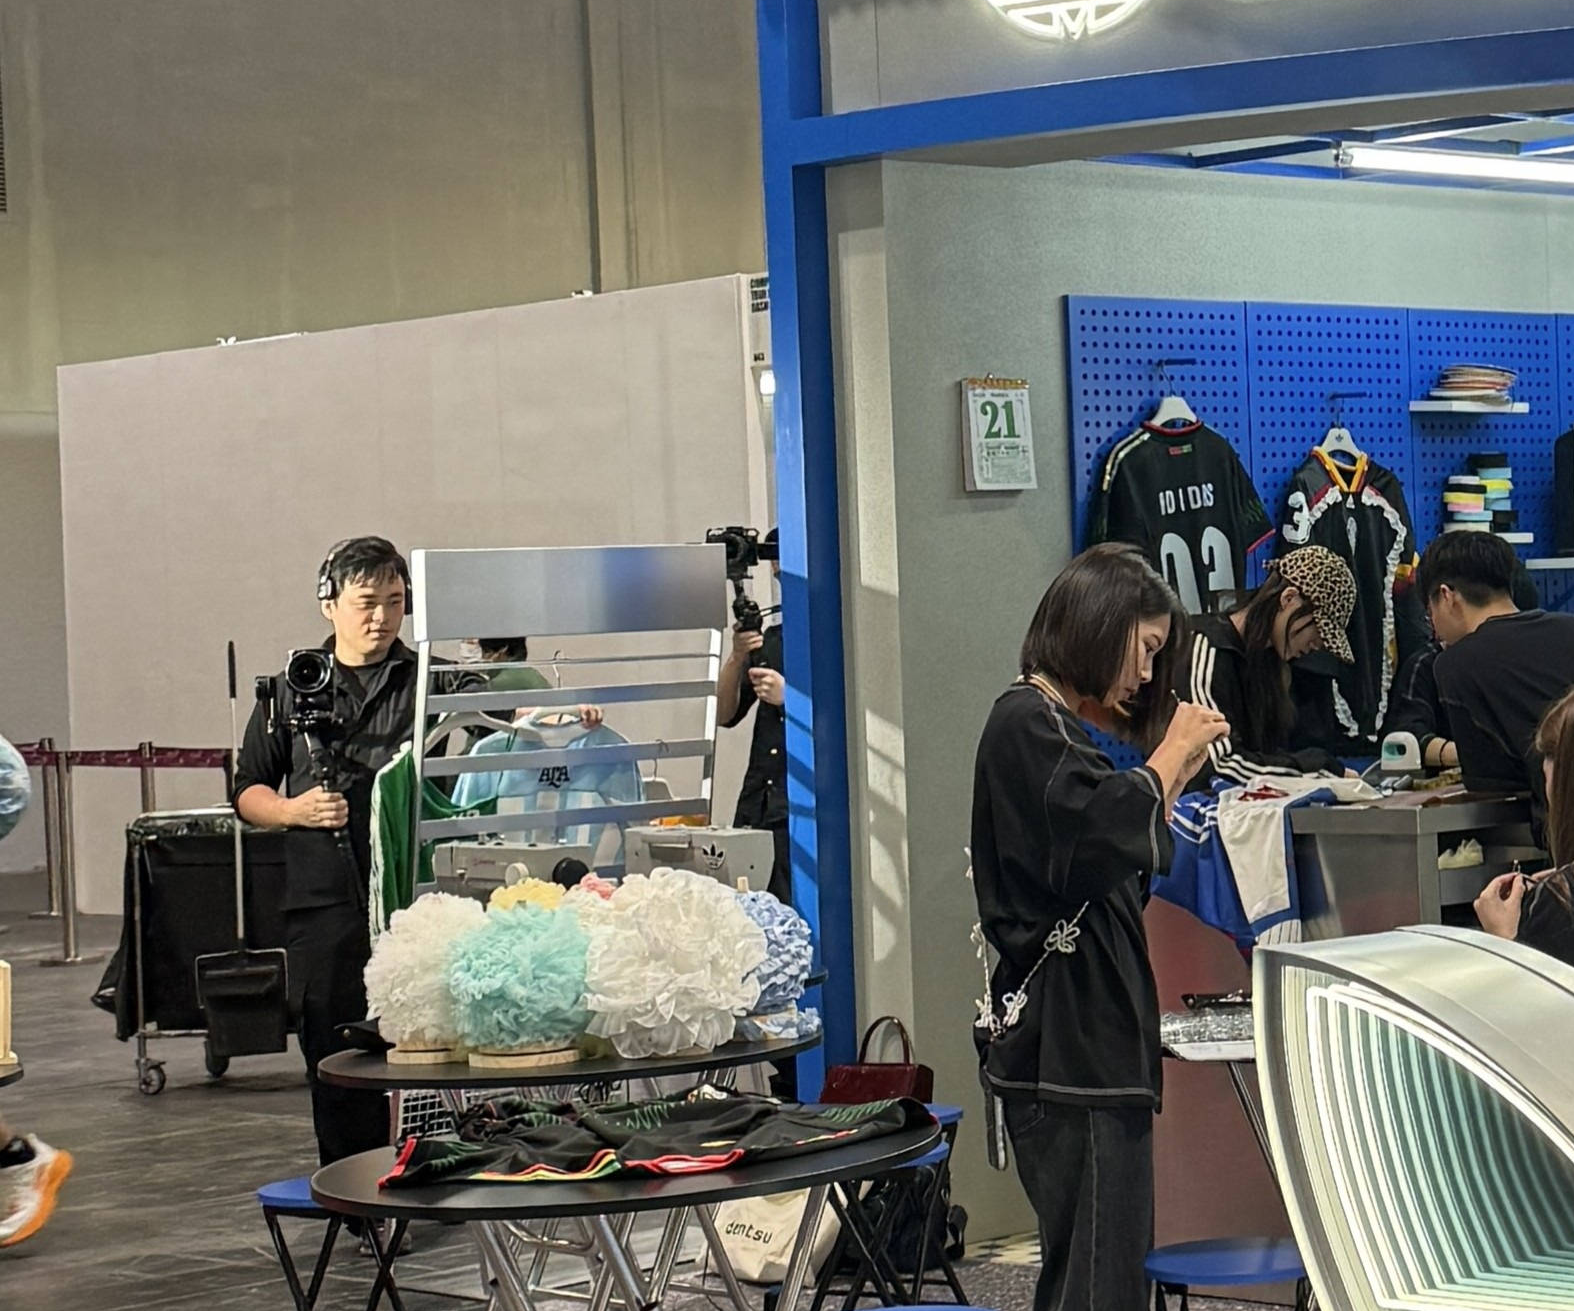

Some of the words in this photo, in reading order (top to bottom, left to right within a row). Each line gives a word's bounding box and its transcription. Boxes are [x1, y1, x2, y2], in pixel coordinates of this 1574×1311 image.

[980, 400, 1021, 439] 21
[1282, 491, 1312, 544] 3
[725, 1220, 773, 1244] dentsu
